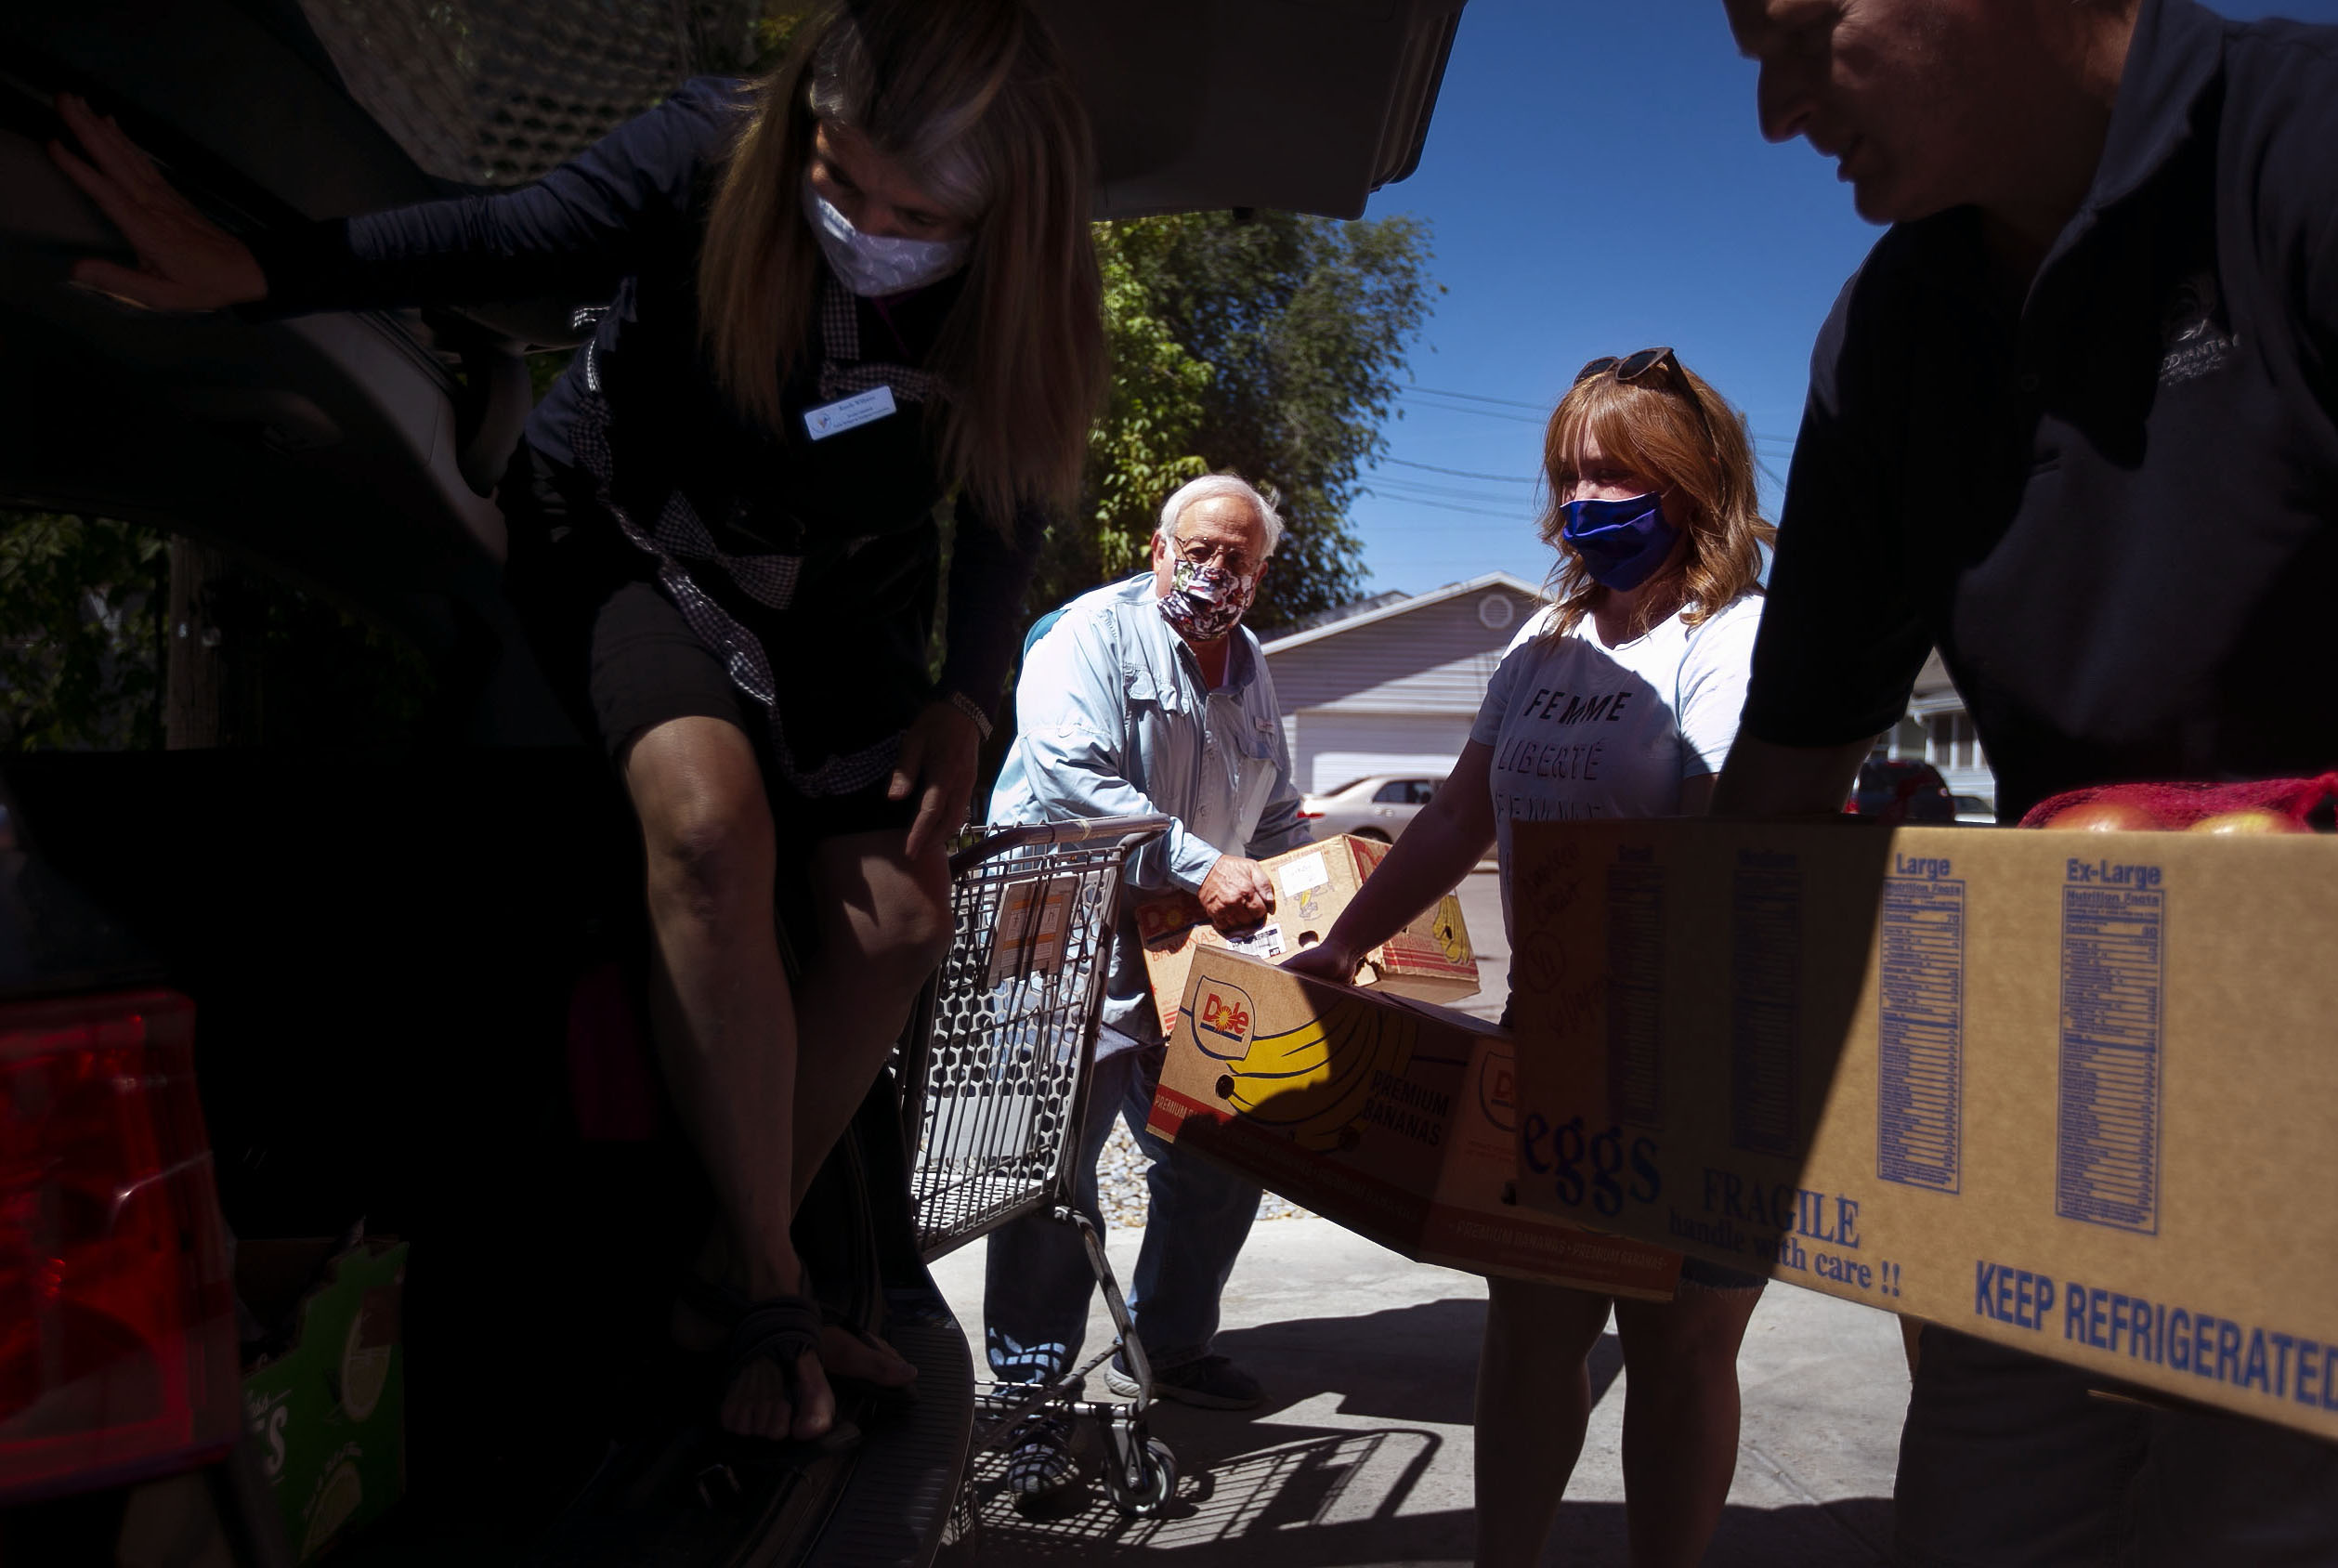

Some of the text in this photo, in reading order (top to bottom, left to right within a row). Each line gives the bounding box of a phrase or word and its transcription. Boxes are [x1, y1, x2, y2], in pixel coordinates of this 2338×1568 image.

[1523, 688, 1633, 725] FEMME
[1896, 853, 1951, 882] Large
[2066, 857, 2162, 890] Ex-Large
[1202, 993, 1249, 1034] Dole
[1154, 1093, 1187, 1121] PREMIUM
[1370, 1069, 1449, 1117] PREMIUM
[1364, 1097, 1443, 1146] BANANAS
[1523, 1112, 1662, 1217] eggs
[1703, 1167, 1860, 1248] FRAGILE
[1456, 1219, 1513, 1246] PREMIUM
[1667, 1205, 1744, 1254] handle
[1754, 1235, 1807, 1272] with
[1814, 1252, 1872, 1289] care
[1975, 1260, 2338, 1412] KEEP REFRIGERATED
